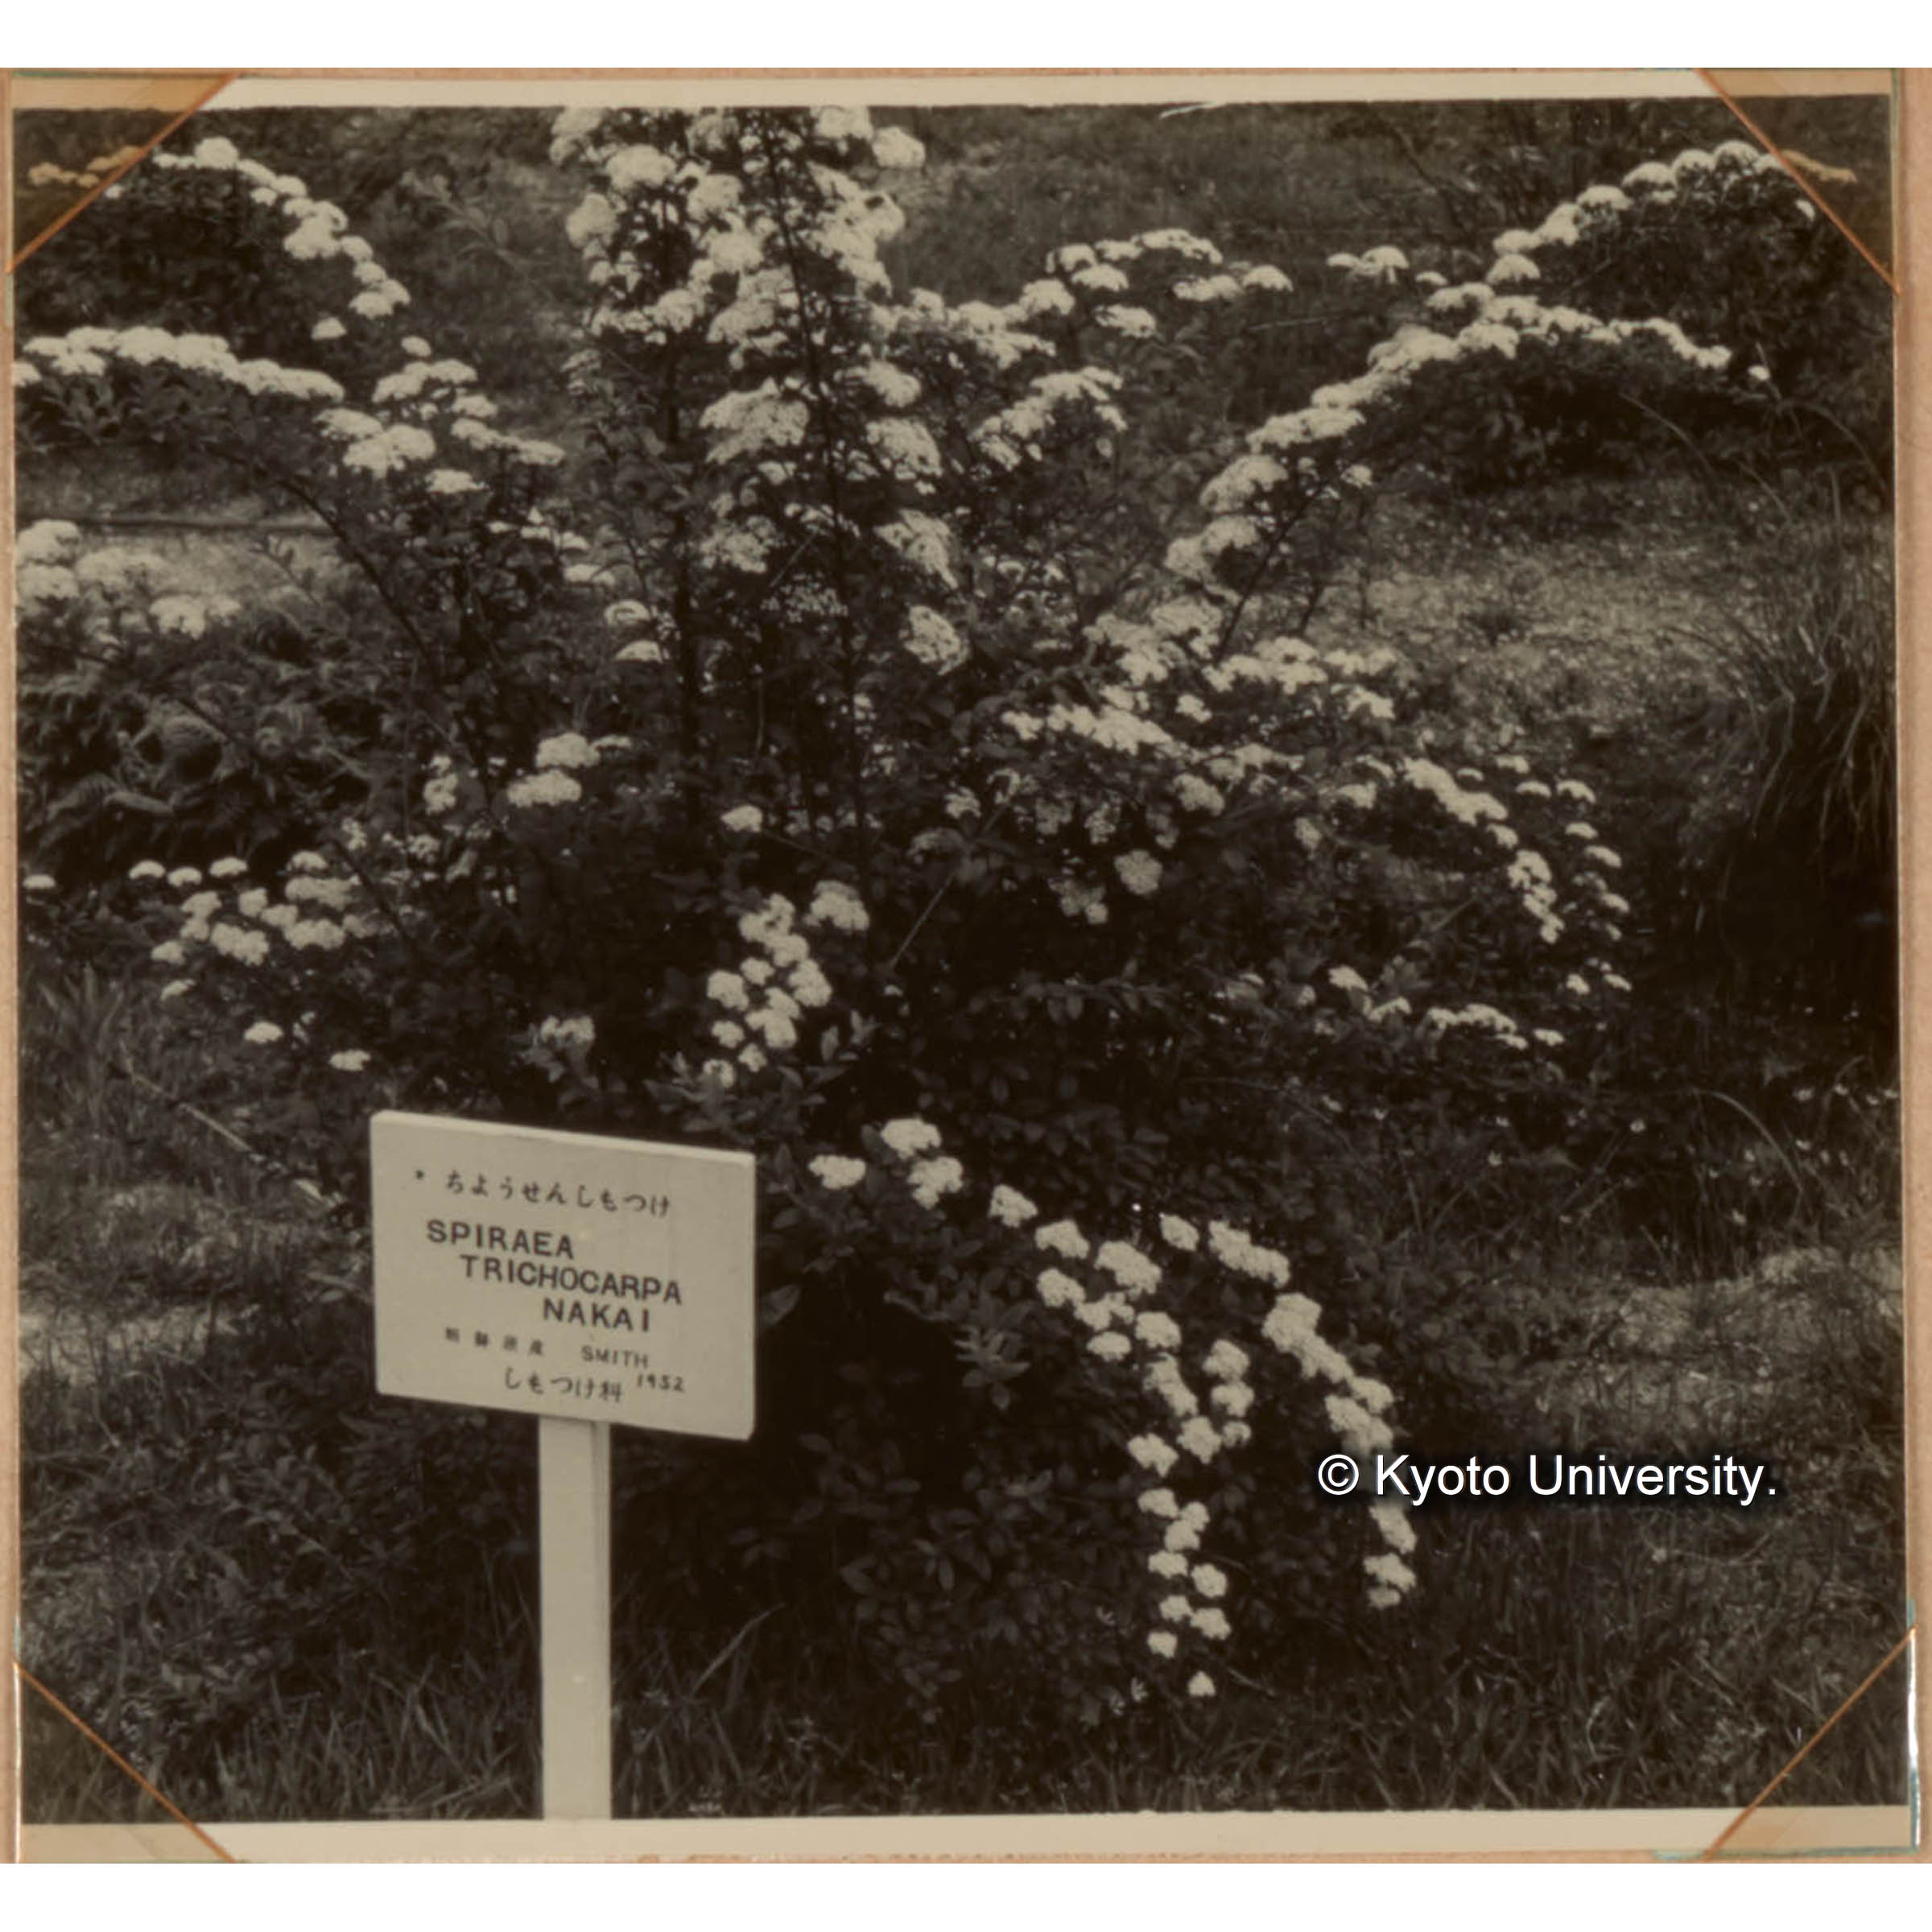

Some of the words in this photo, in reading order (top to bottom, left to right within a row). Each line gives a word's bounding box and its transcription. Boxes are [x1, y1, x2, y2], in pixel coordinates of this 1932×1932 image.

[426, 1218, 574, 1261] SPIRAEA
[460, 1253, 683, 1307] TRICHOCARPA
[543, 1297, 650, 1333] NAKAI
[581, 1345, 649, 1369] SMITH
[637, 1373, 684, 1393] 1952
